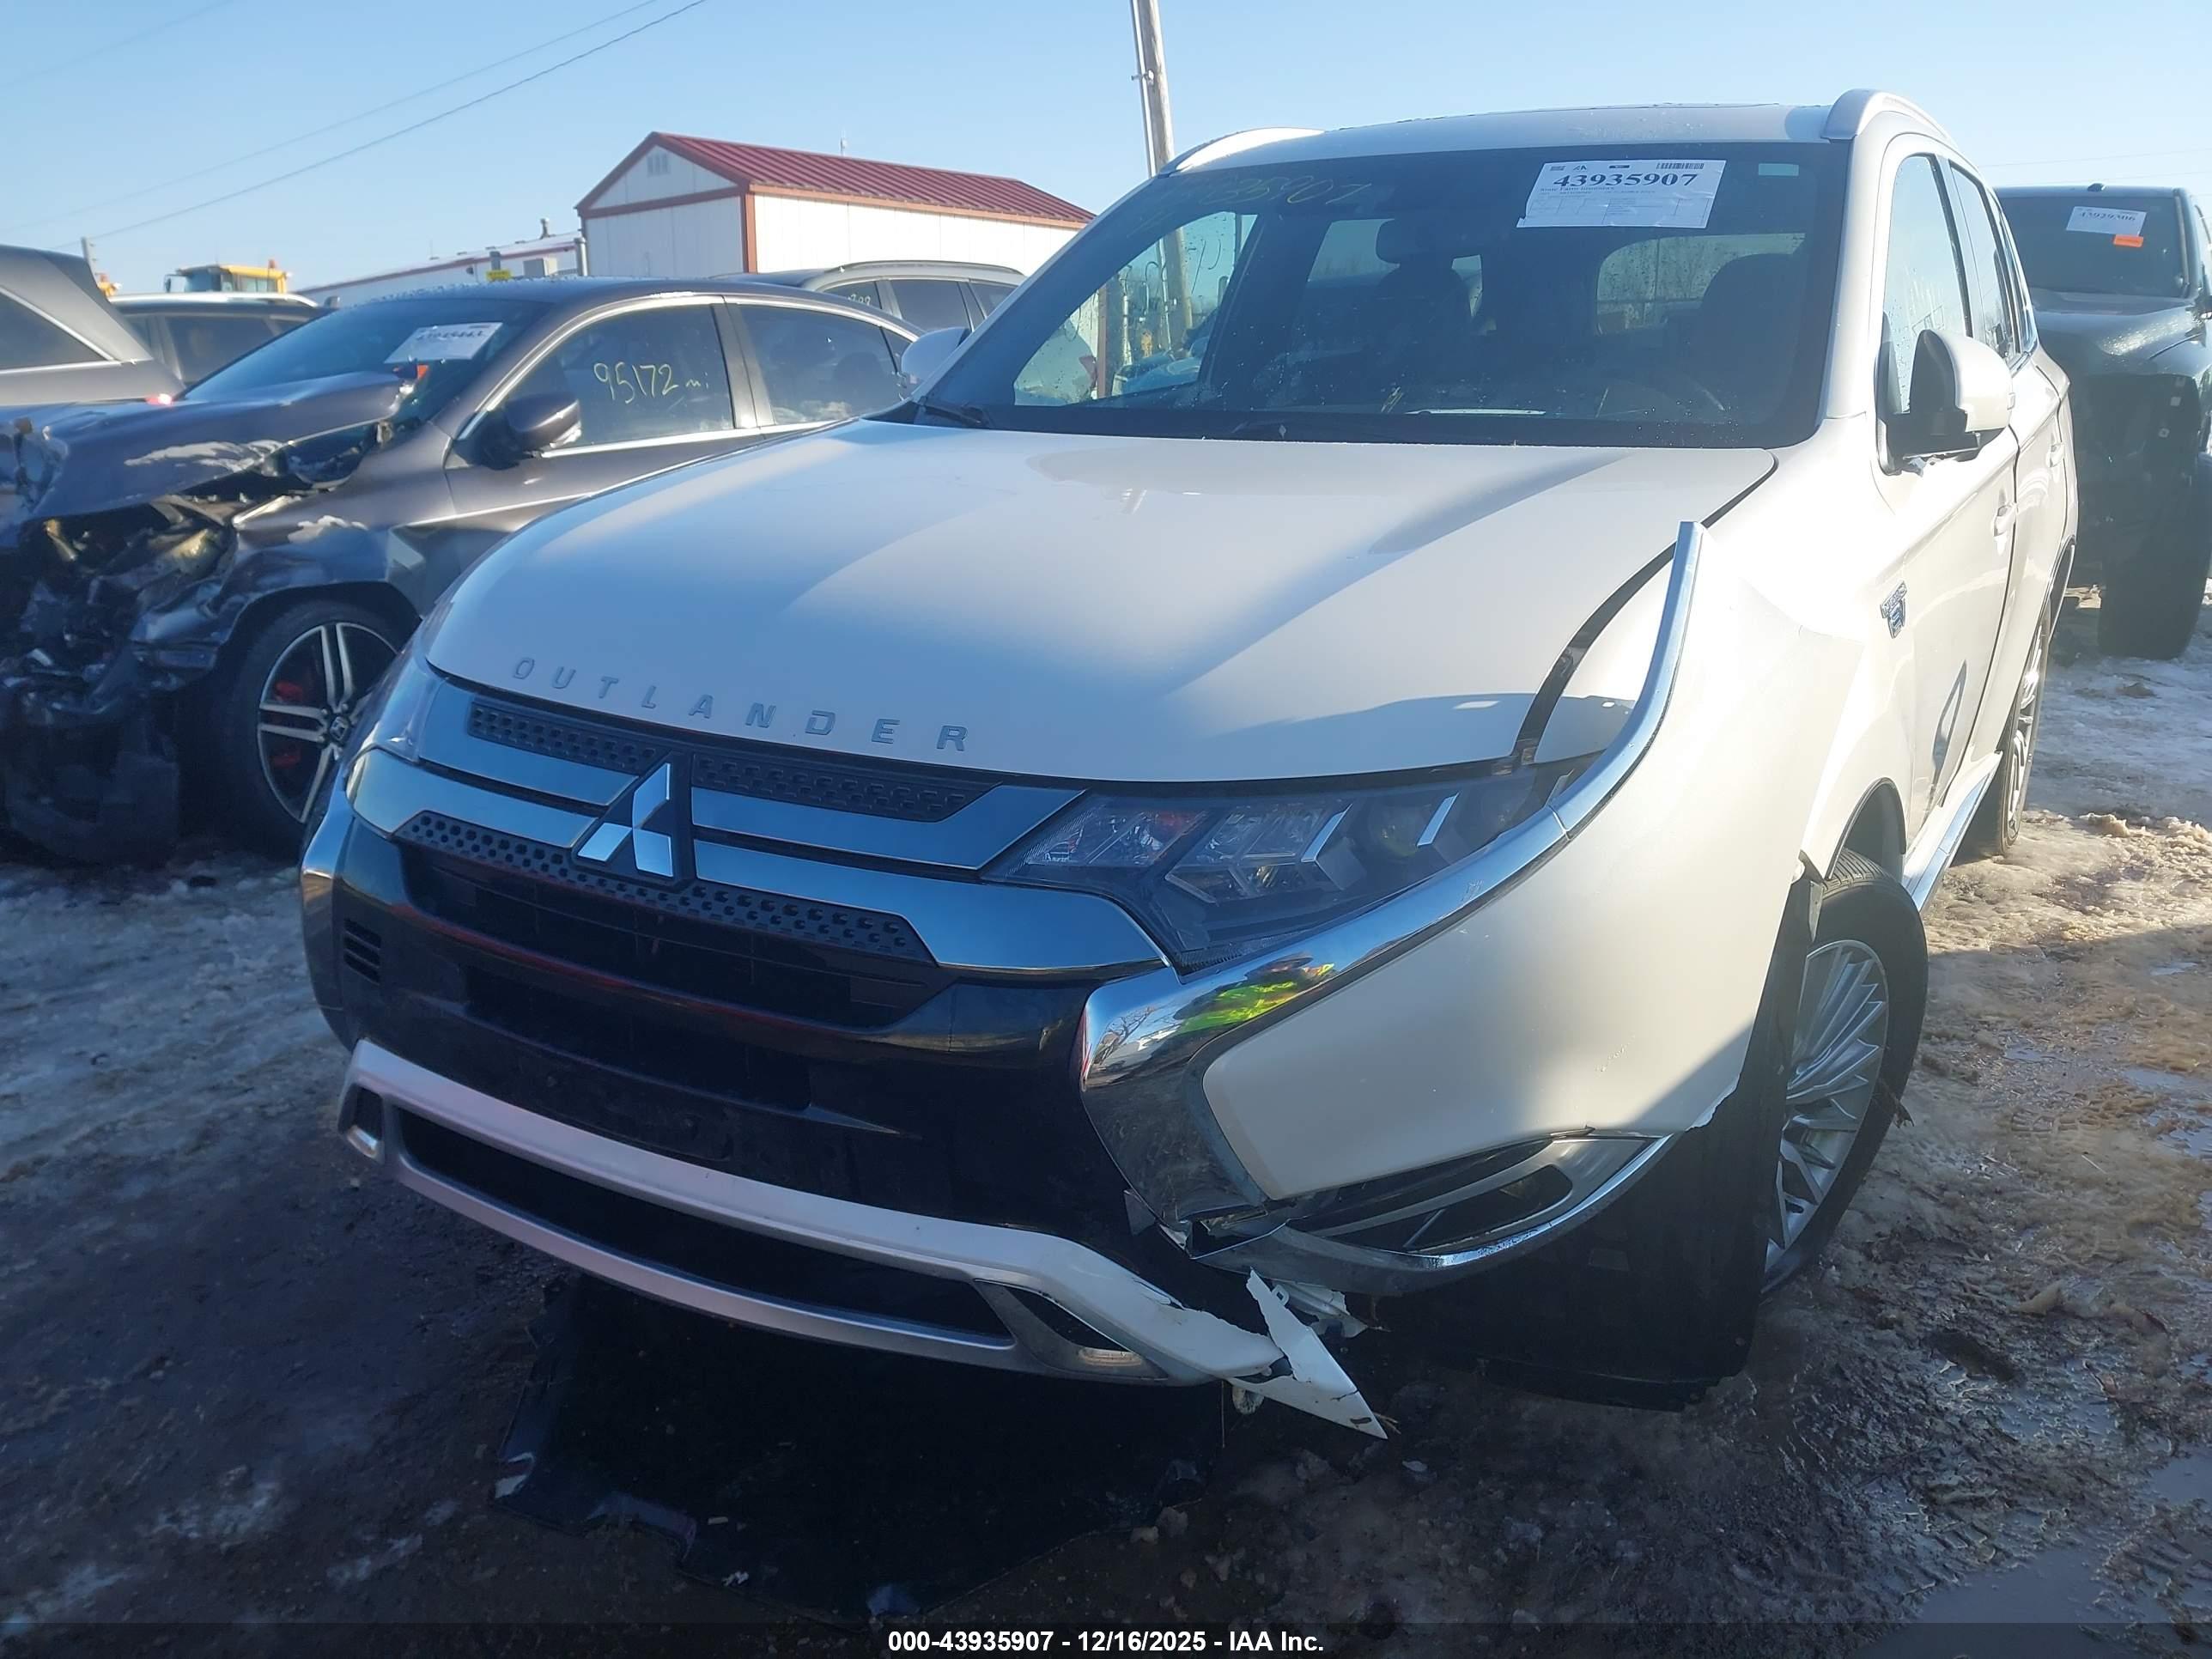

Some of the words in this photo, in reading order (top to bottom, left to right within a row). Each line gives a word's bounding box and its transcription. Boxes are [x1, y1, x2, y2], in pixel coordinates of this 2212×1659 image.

[1553, 173, 1698, 187] 43935907
[593, 362, 678, 404] 95172
[512, 657, 969, 751] OUTLANDER
